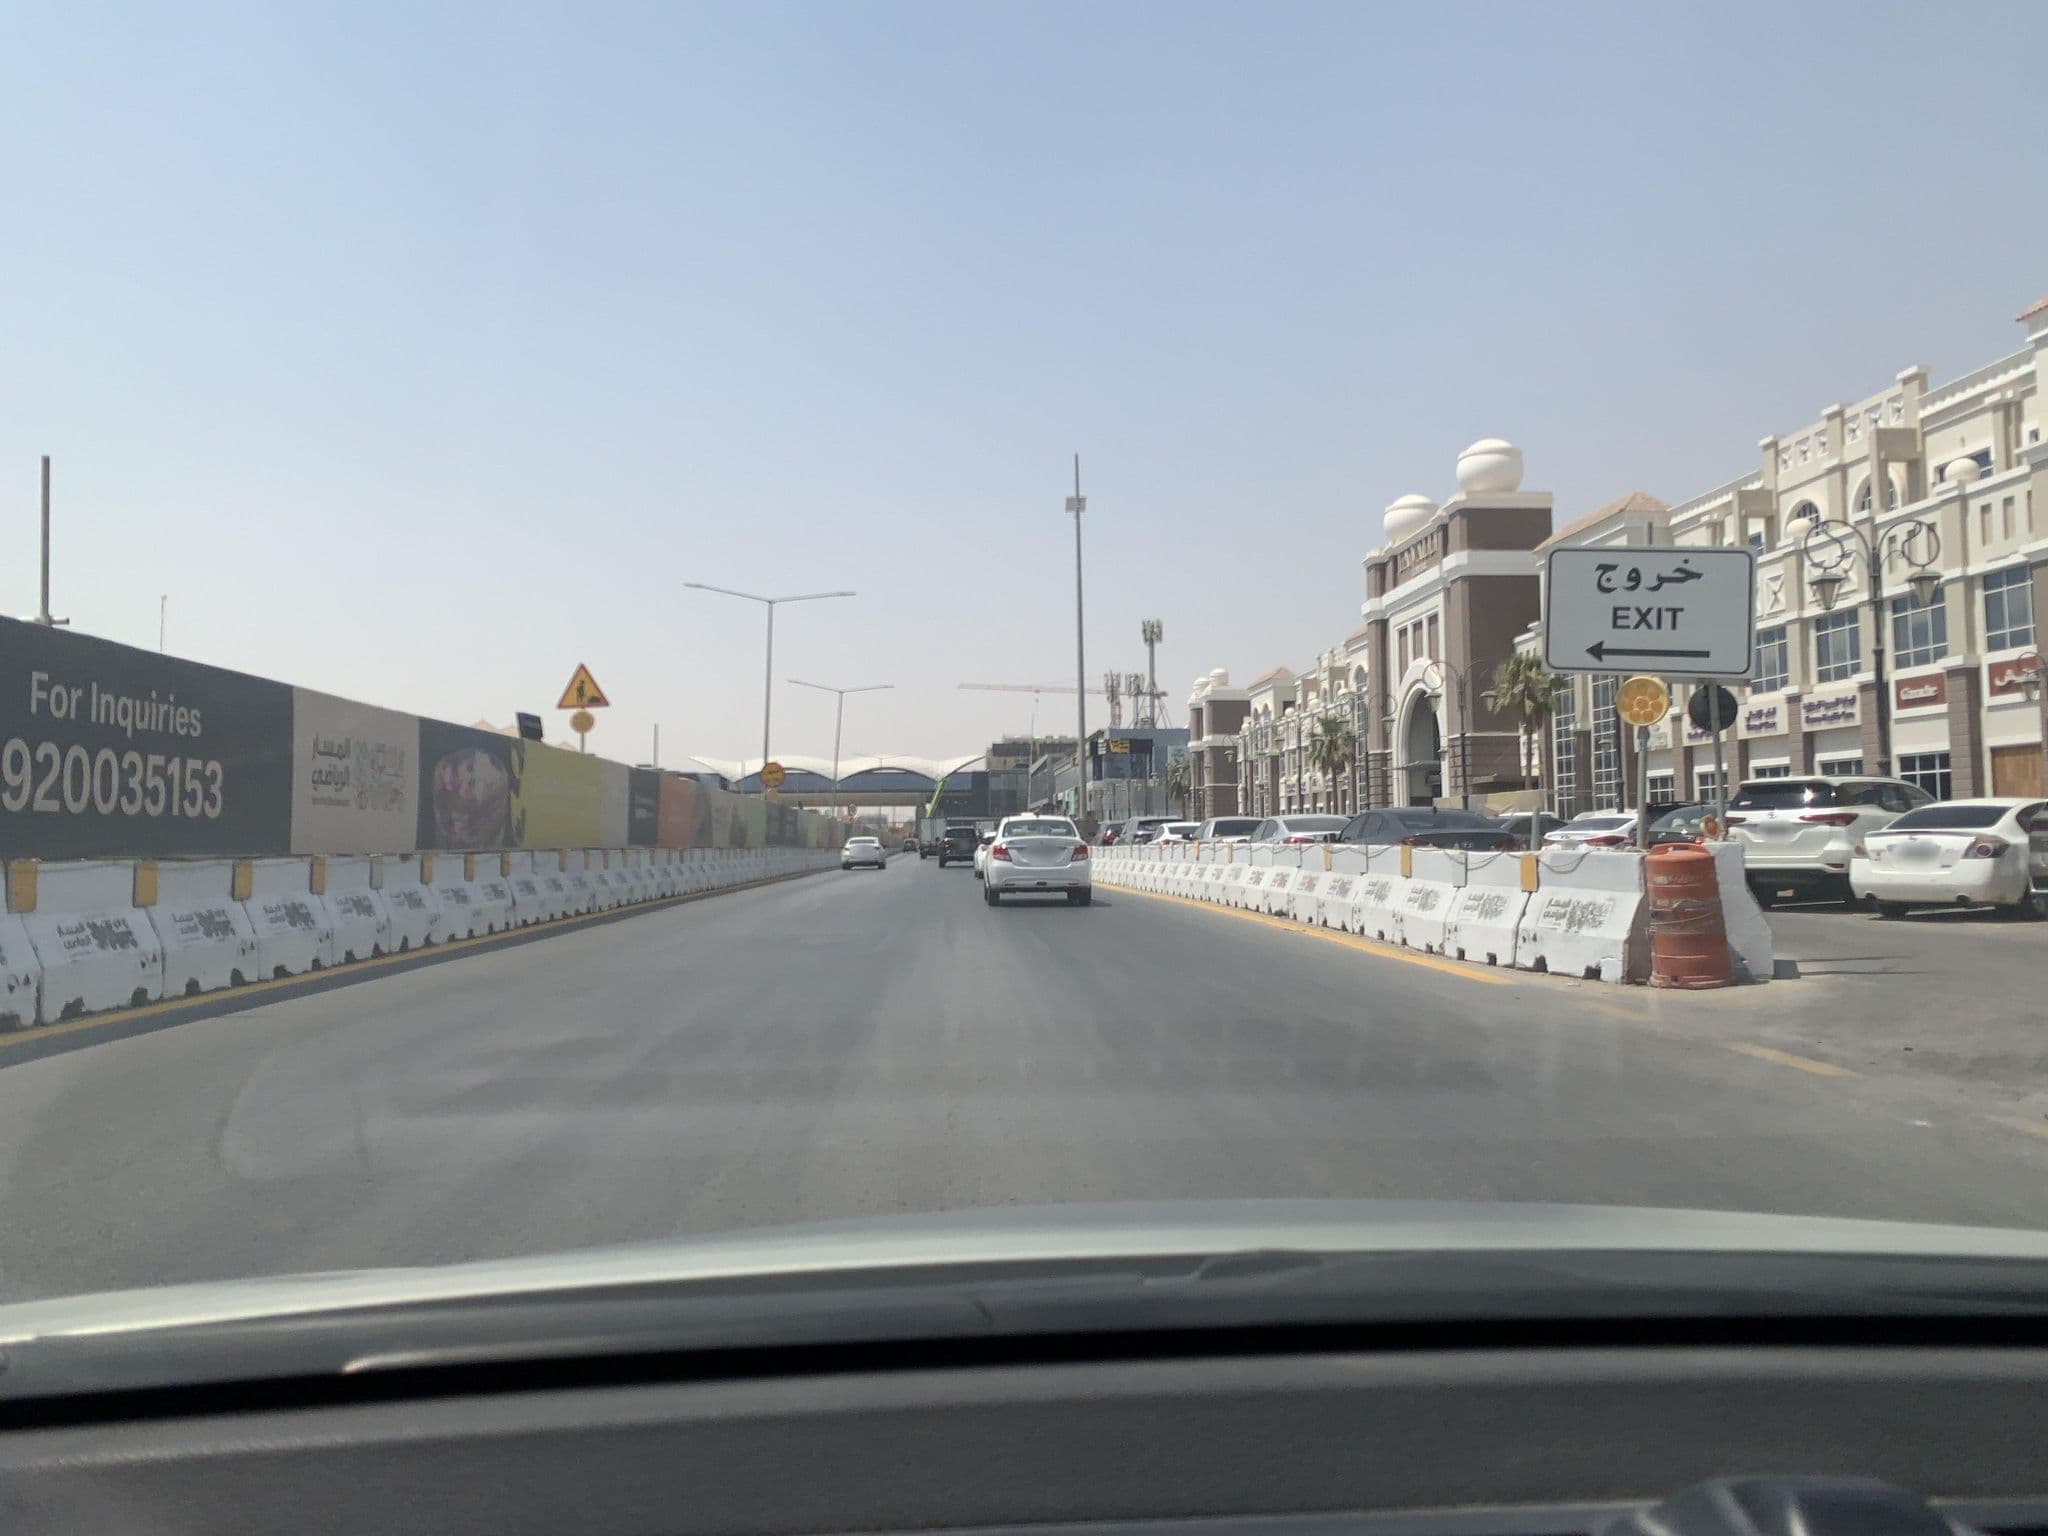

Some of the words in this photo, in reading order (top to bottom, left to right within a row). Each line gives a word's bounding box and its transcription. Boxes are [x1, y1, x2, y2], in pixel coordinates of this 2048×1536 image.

[1595, 558, 1704, 593] خروج
[1611, 606, 1684, 630] EXIT
[30, 671, 82, 720] For
[90, 681, 202, 738] Inquiries
[1, 737, 223, 819] 920035153
